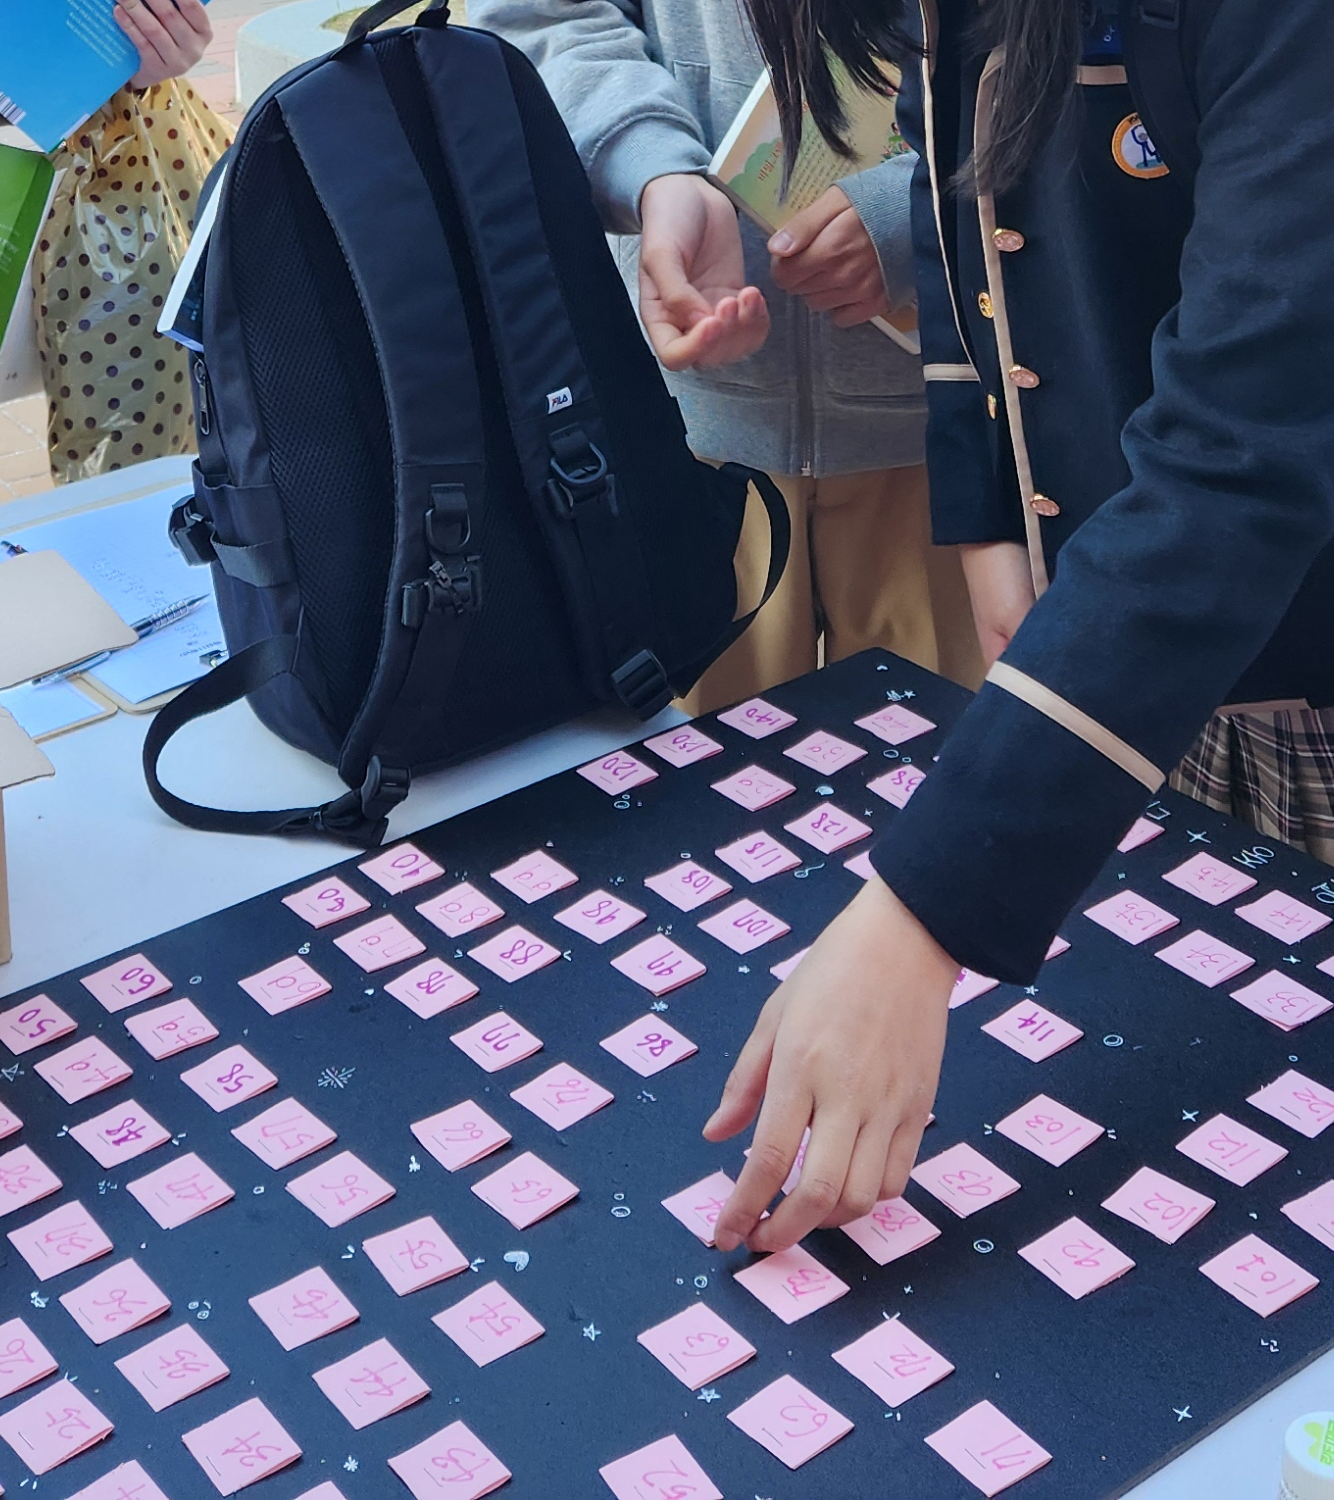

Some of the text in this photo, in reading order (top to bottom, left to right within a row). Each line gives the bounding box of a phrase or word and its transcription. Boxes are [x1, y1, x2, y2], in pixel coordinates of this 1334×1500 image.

[552, 394, 568, 407] FILA
[746, 708, 782, 726] 140
[602, 757, 637, 781] 120
[890, 770, 917, 792] 38
[811, 812, 848, 837] 128
[745, 842, 782, 869] 118
[1232, 846, 1275, 869] 중
[681, 869, 714, 895] 108
[316, 888, 345, 912] 80
[440, 891, 491, 924] 89
[582, 900, 621, 926] 98
[733, 909, 774, 937] 107
[1114, 903, 1163, 931] 135
[500, 940, 544, 966] 88
[1186, 945, 1238, 974] 134
[120, 967, 156, 995] 60
[267, 966, 322, 1001] 69
[1267, 991, 1317, 1019] 133
[19, 1008, 56, 1038] 50
[1017, 1010, 1055, 1042] 114
[636, 1033, 673, 1057] 86
[65, 1054, 117, 1083] 49
[217, 1063, 253, 1093] 58
[105, 1118, 146, 1147] 48
[260, 1115, 313, 1151] 57
[443, 1122, 483, 1142] 66
[1026, 1114, 1081, 1144] 103
[1208, 1132, 1260, 1166] 112
[321, 1174, 368, 1206] 56
[511, 1180, 552, 1204] 65
[942, 1170, 992, 1196] 93
[1143, 1192, 1197, 1230] 102
[1062, 1240, 1105, 1268] 92
[1236, 1254, 1296, 1294] 101
[92, 1289, 147, 1321] 36
[292, 1290, 339, 1320] 45
[469, 1302, 520, 1336] 54
[681, 1332, 729, 1357] 63
[890, 1344, 931, 1377] 72
[350, 1362, 407, 1397] 44
[46, 1408, 91, 1439] 25
[780, 1395, 828, 1437] 62
[222, 1432, 281, 1467] 34
[981, 1434, 1032, 1470] 71
[431, 1448, 489, 1483] 43
